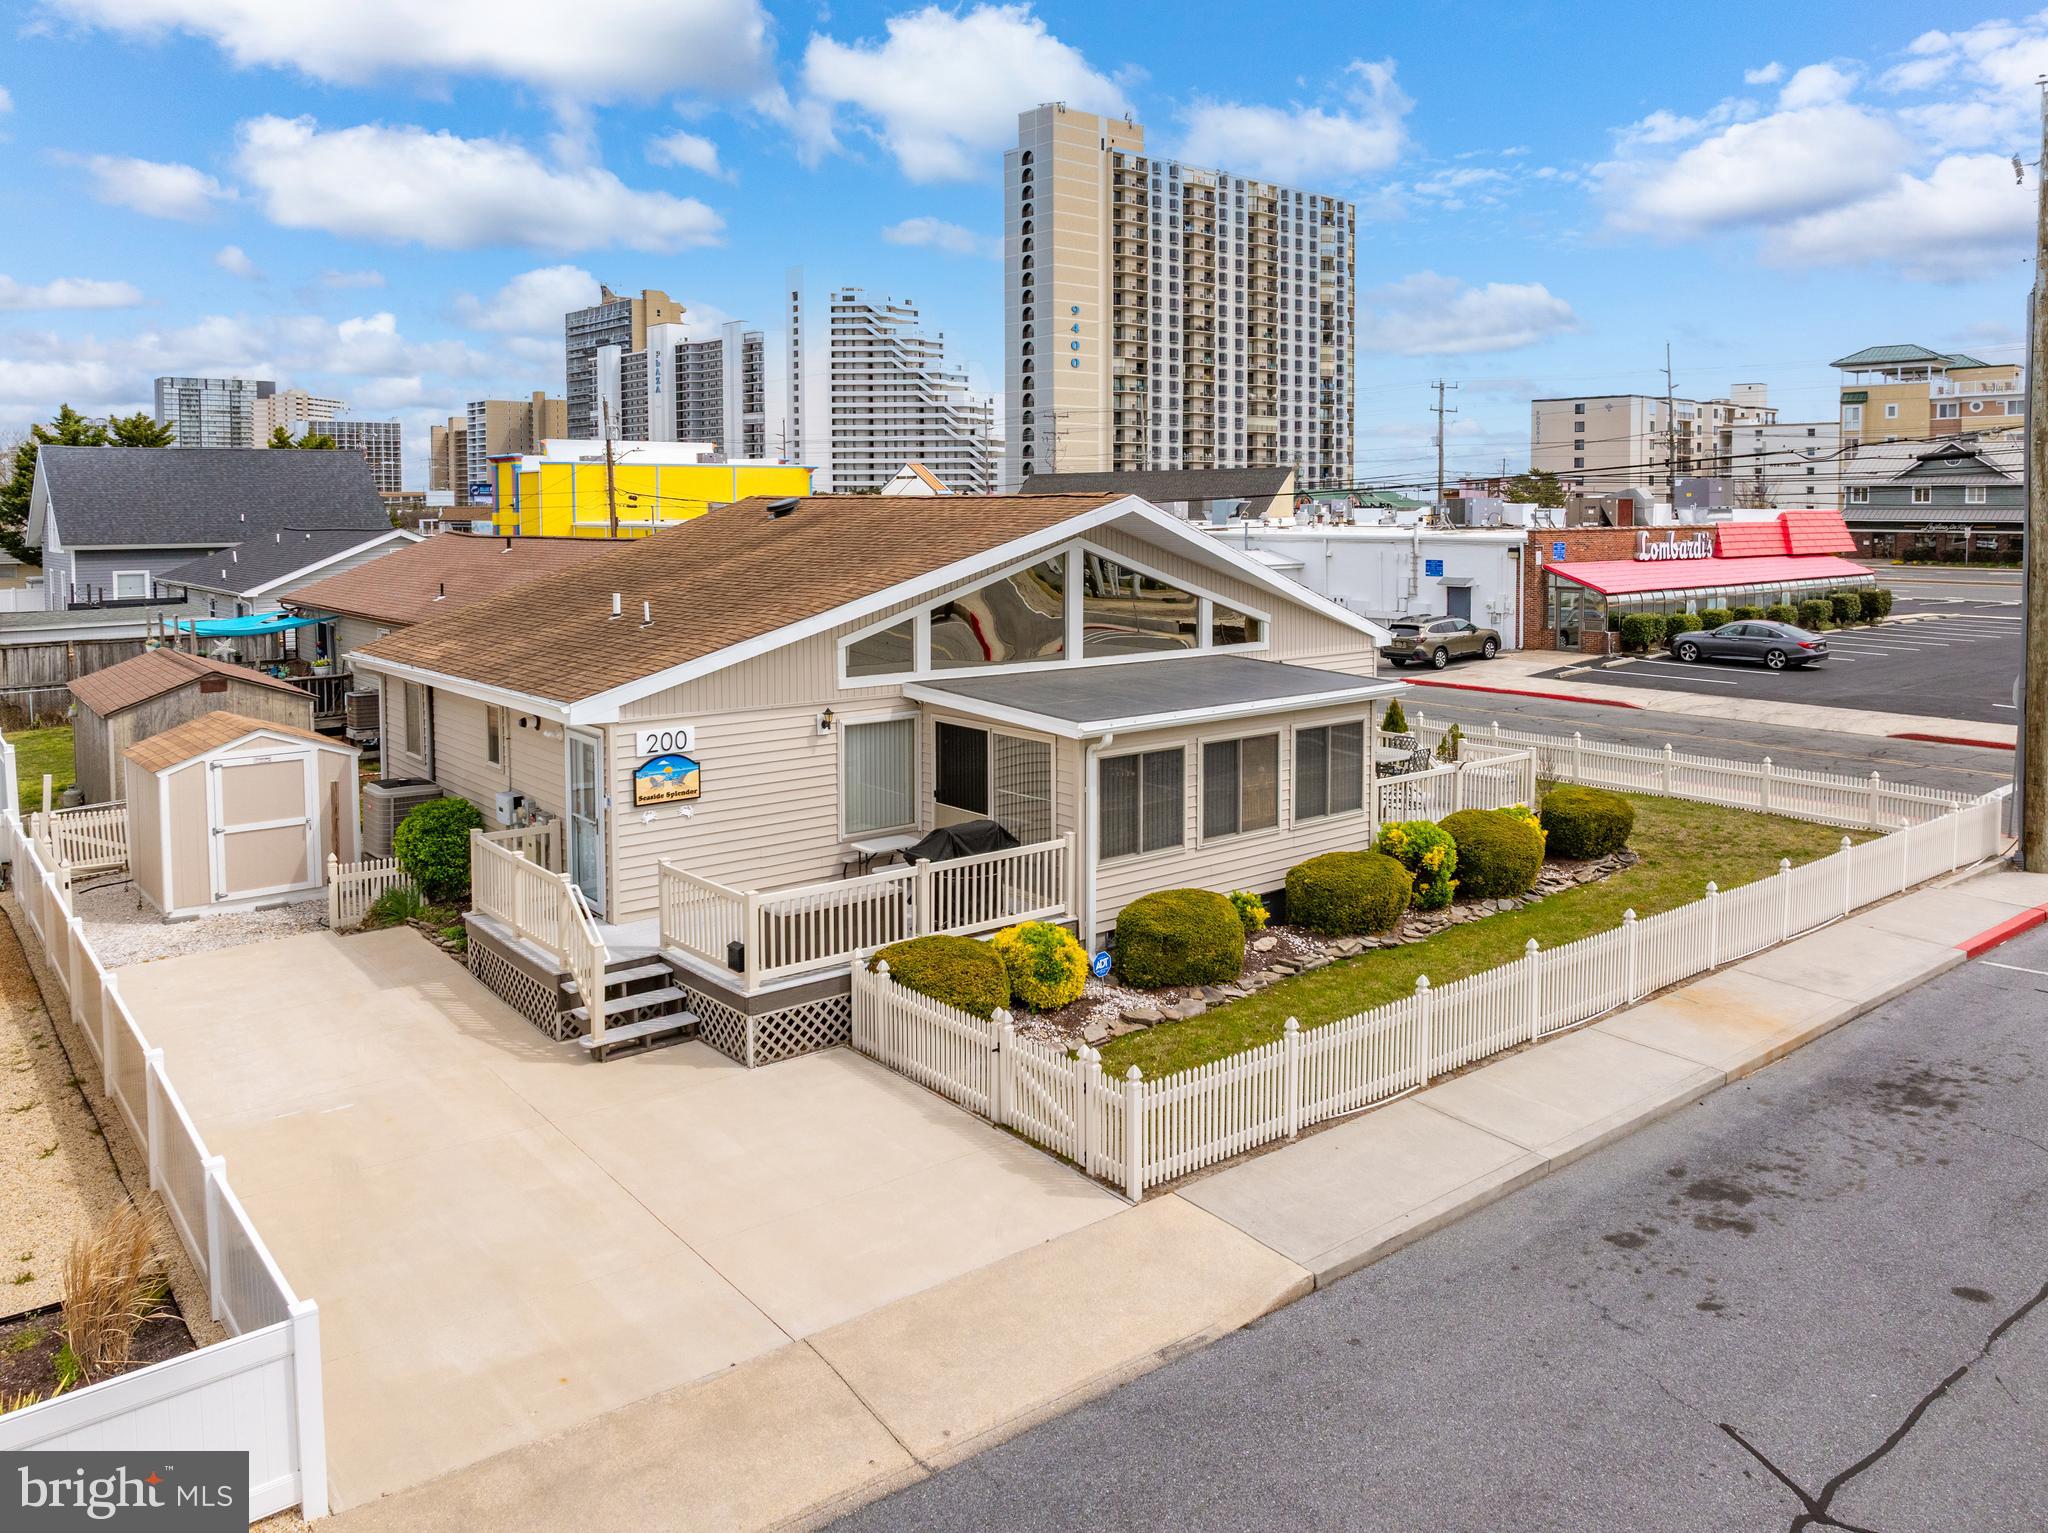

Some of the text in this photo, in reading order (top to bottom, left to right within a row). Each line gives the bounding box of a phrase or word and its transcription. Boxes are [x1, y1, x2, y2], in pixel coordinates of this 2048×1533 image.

[1070, 305, 1081, 369] 9400
[1638, 530, 1713, 561] Lombardi's
[646, 730, 688, 754] 200
[638, 788, 698, 802] Seaside Splender
[1096, 957, 1109, 970] ADT
